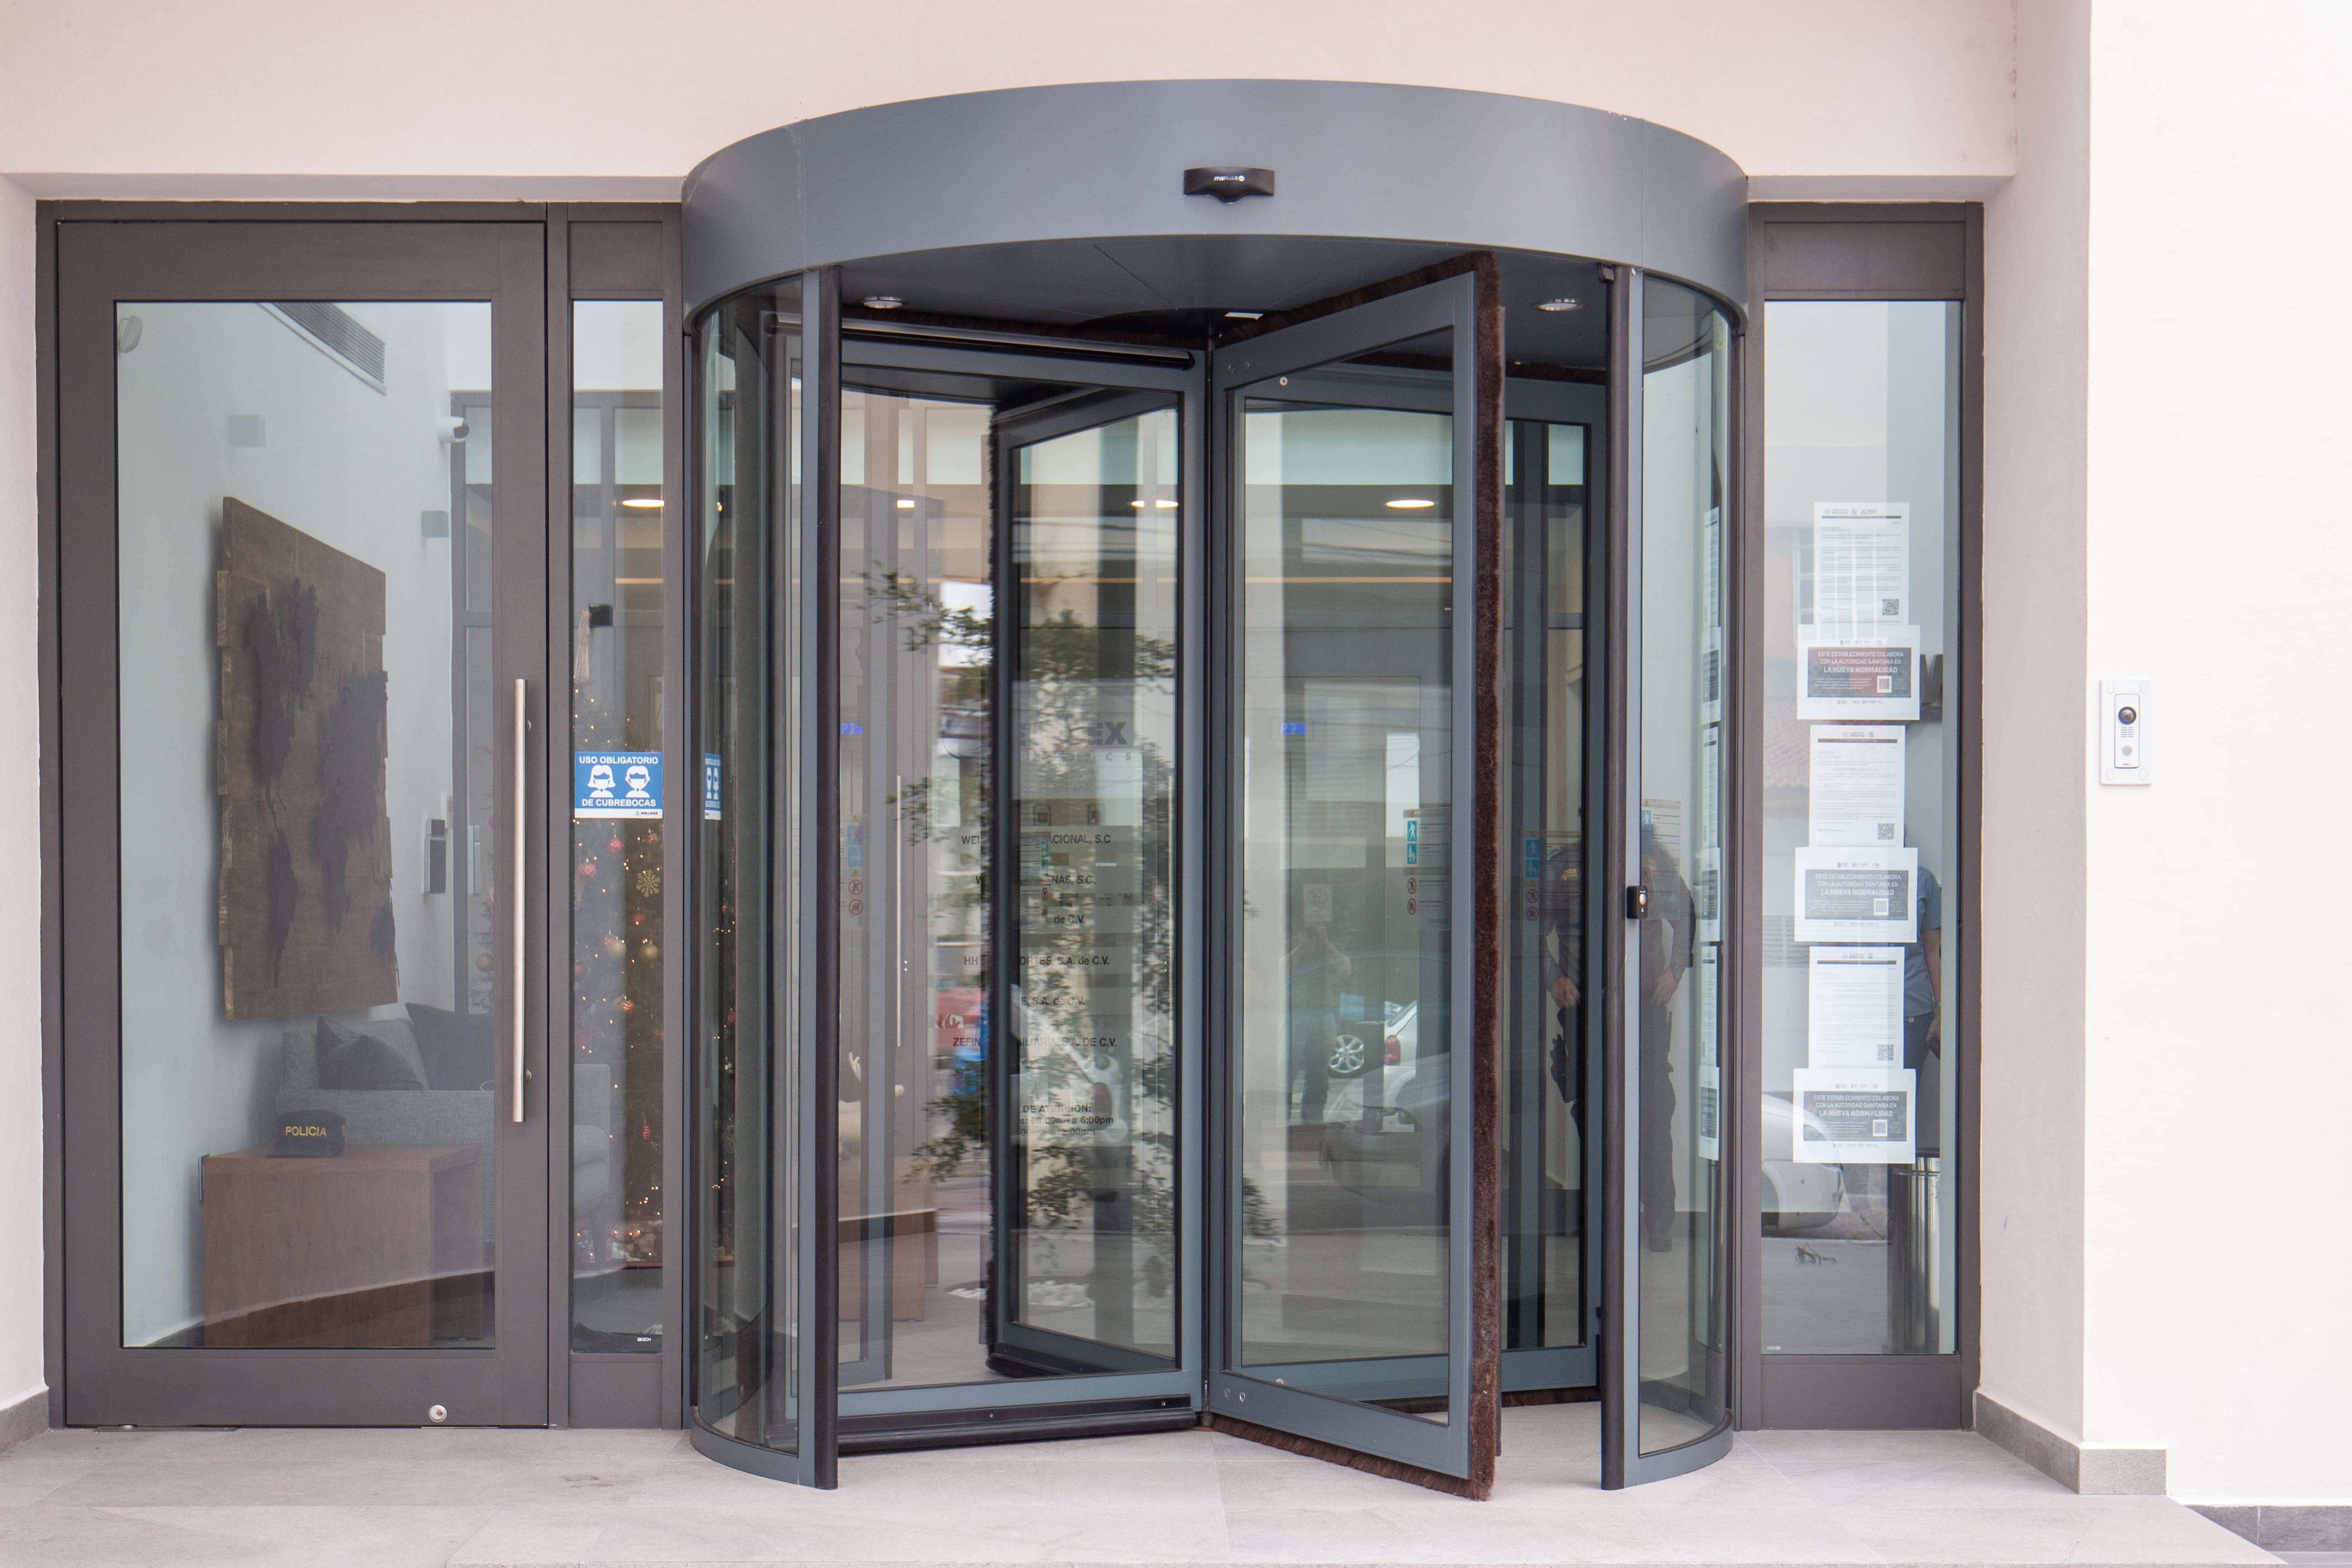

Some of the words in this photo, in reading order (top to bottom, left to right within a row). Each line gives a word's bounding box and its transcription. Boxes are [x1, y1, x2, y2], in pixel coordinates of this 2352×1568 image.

[600, 756, 659, 765] OBLIGATORIO
[582, 798, 594, 807] DE
[596, 799, 656, 807] CUBREBOCAS
[1052, 875, 1074, 885] NAS,
[1077, 875, 1096, 884] S.C.
[1054, 915, 1065, 923] de
[1068, 914, 1085, 923] C.V.
[964, 956, 978, 965] HH
[1020, 956, 1053, 966] ORTES,
[1057, 956, 1075, 965] S.A.
[1078, 956, 1089, 965] de
[1092, 956, 1109, 965] C.V.
[1033, 997, 1051, 1005] S.A.
[1053, 996, 1065, 1005] de
[1068, 996, 1085, 1005] C.V.
[1083, 1037, 1096, 1047] DE
[1099, 1037, 1117, 1047] C.V.
[1080, 1116, 1114, 1125] 6:00pm
[285, 1126, 327, 1137] POLICIA
